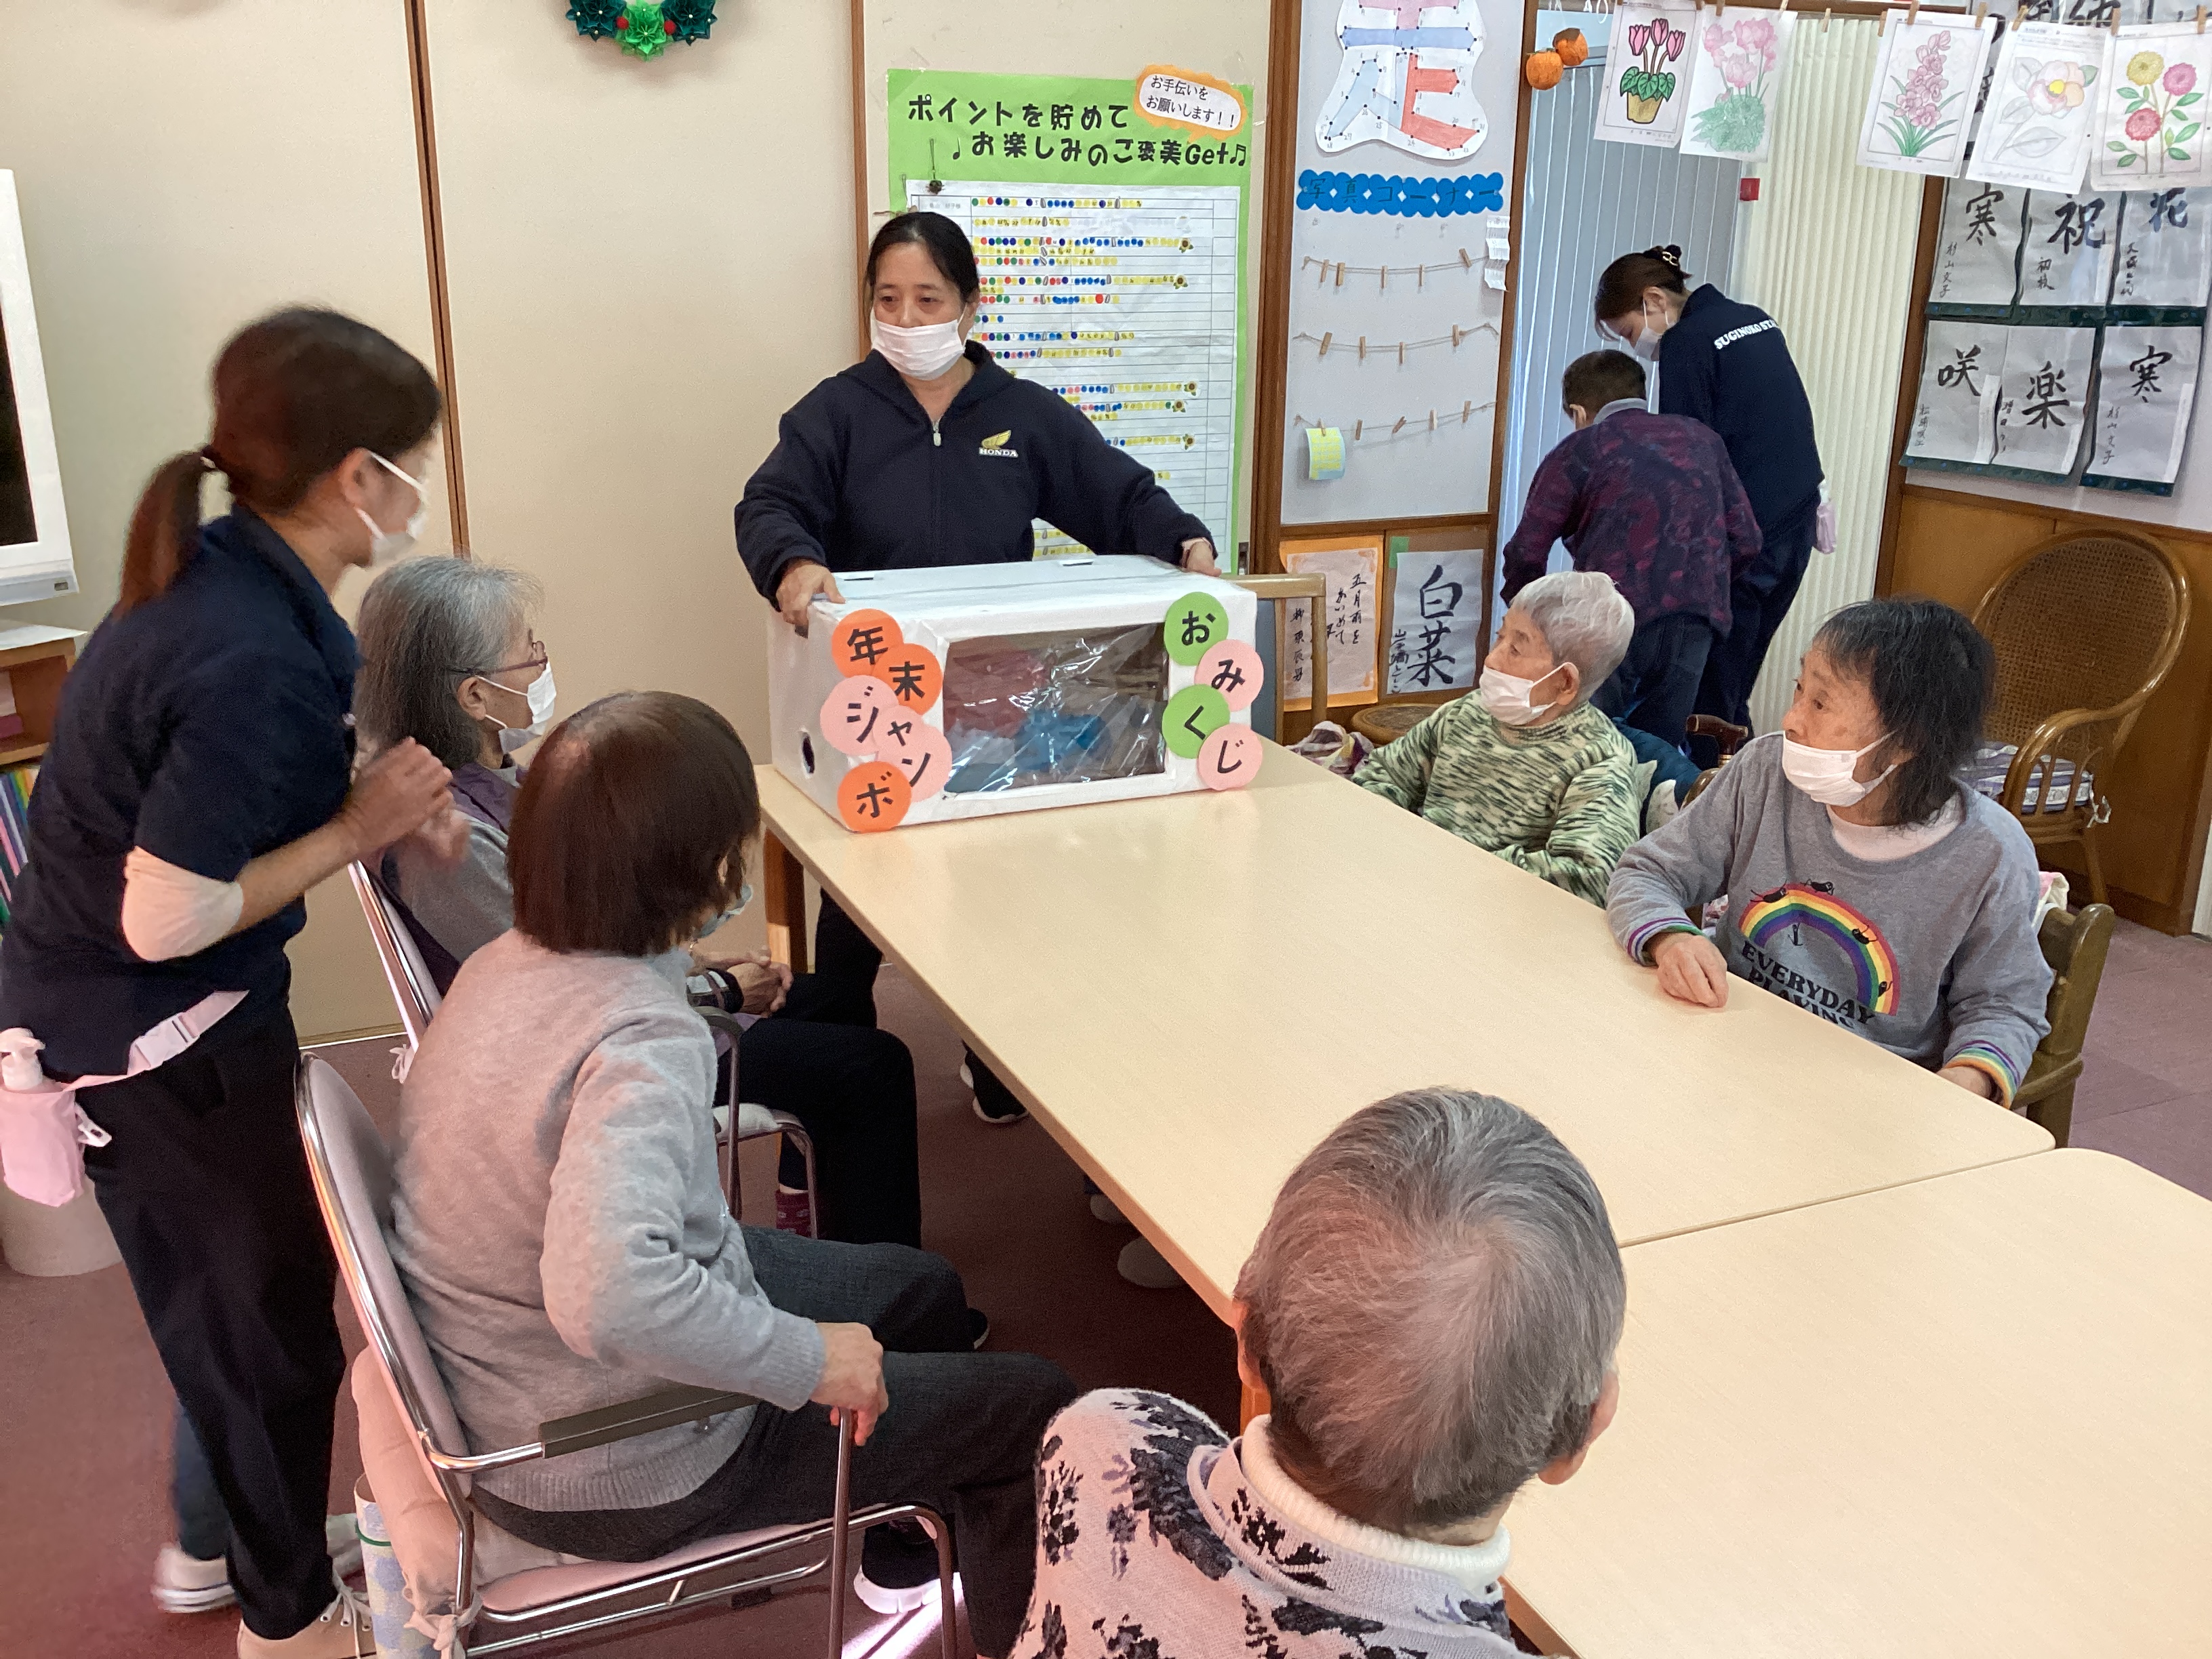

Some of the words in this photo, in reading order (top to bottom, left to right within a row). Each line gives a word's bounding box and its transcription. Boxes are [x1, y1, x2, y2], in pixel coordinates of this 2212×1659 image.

[908, 94, 1129, 131] ポイントを貯めて
[1151, 75, 1208, 100] お手伝いを
[1308, 178, 1496, 206] 写真コーナー
[1965, 182, 2004, 246] 寒
[2047, 194, 2106, 254] 祝
[1938, 344, 1981, 397] 咲
[2022, 361, 2070, 429] 楽
[2129, 345, 2173, 403] 寒
[979, 447, 1019, 457] HONDA
[1406, 565, 1463, 687] 白菜
[1181, 610, 1246, 775] おみくじ
[1741, 940, 1877, 1025] EVERYDAY
